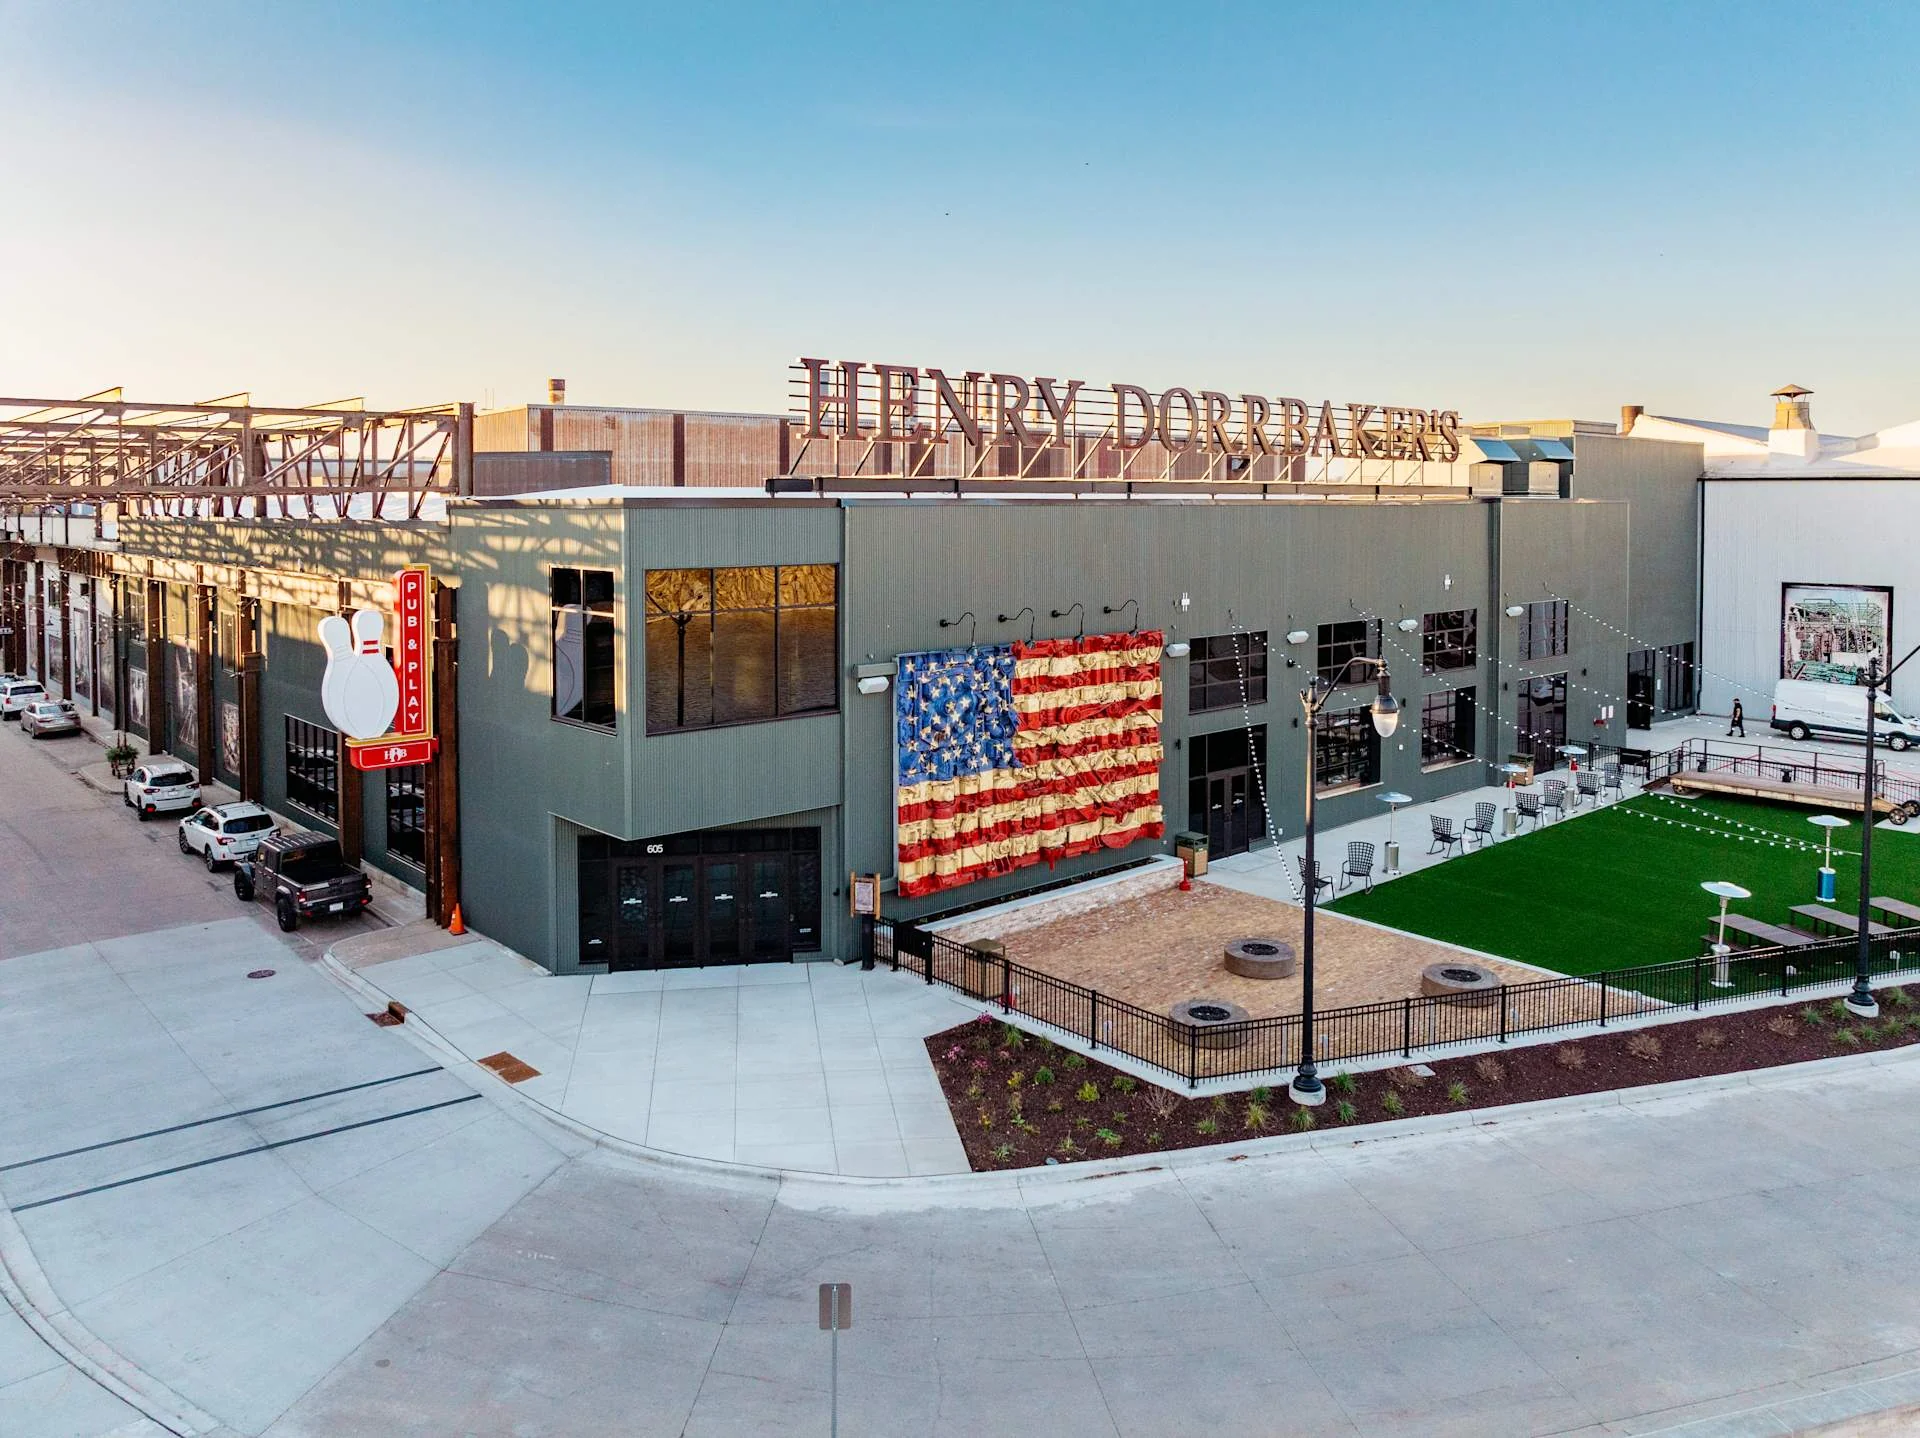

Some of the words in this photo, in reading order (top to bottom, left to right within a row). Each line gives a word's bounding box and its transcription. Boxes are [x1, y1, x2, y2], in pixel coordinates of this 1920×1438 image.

[797, 357, 1085, 449] HENRY
[1109, 383, 1459, 463] DORRBAKER'S
[408, 581, 418, 627] PUB
[408, 638, 418, 650] &
[408, 662, 419, 724] PLAY
[646, 844, 664, 854] 605
